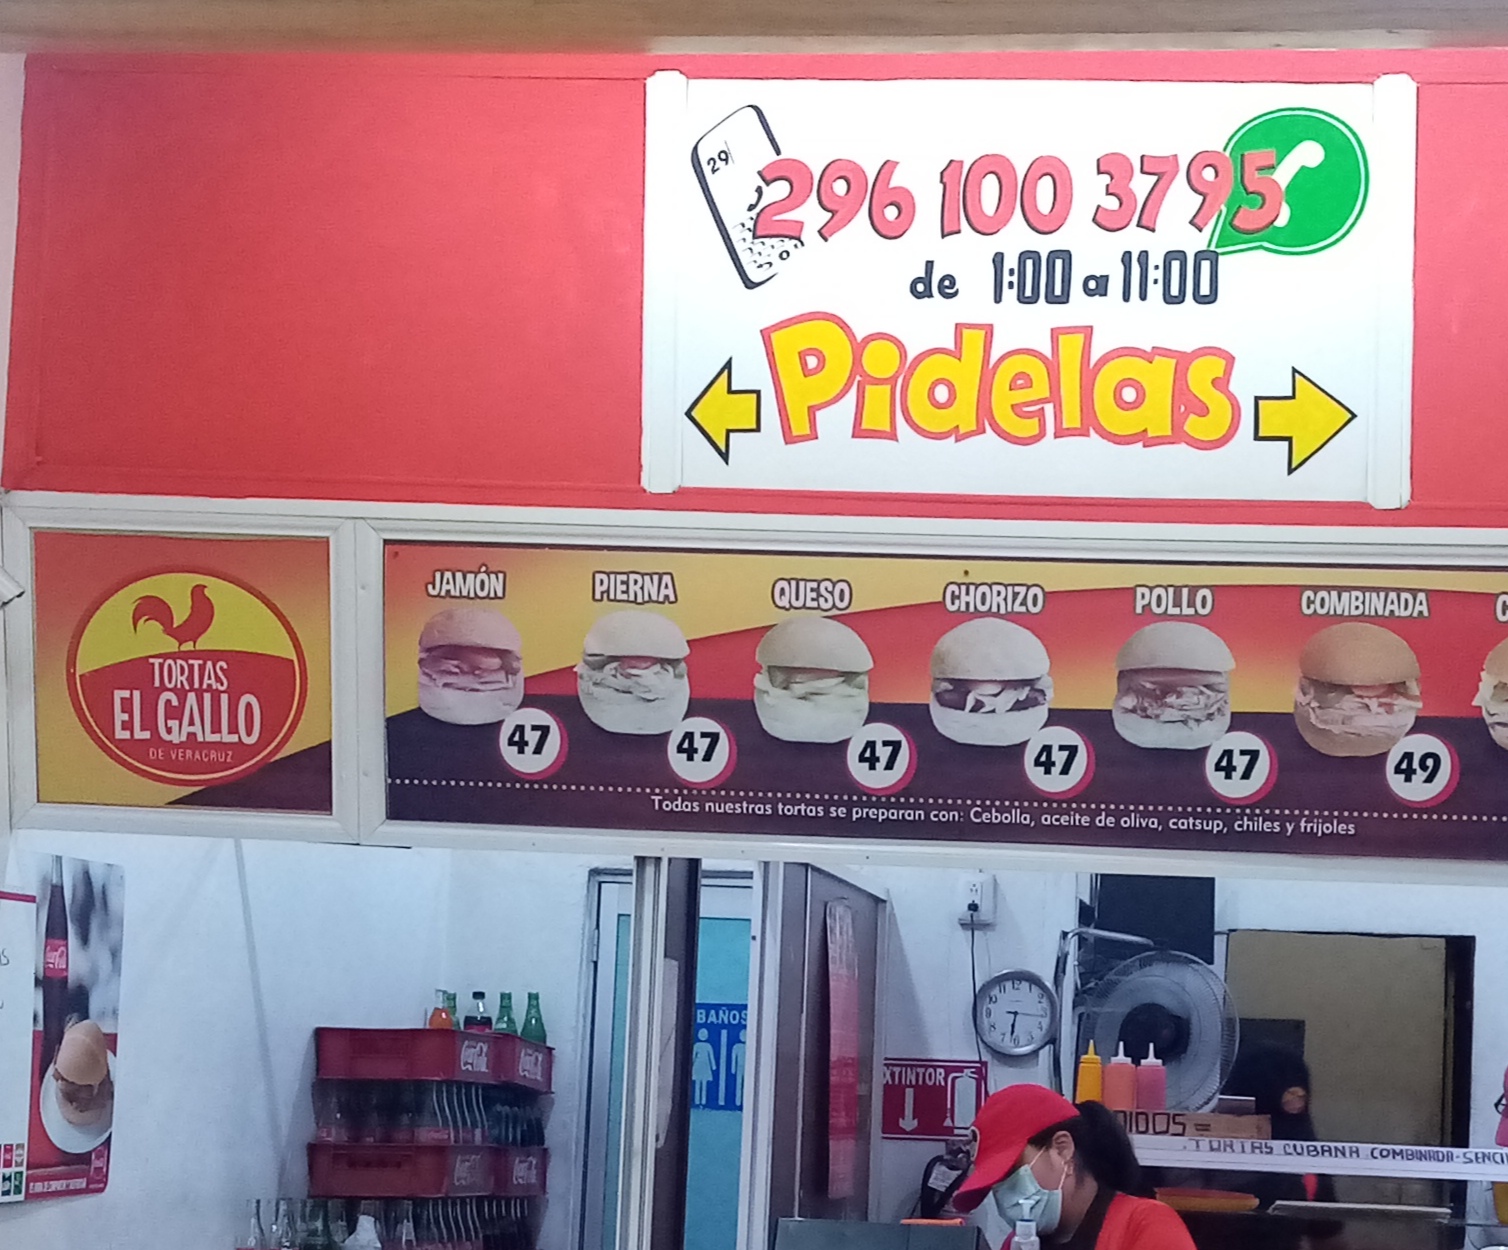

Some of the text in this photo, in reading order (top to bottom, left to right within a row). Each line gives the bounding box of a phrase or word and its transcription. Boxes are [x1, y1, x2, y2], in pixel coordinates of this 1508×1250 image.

[753, 149, 1286, 243] 296 100 3795
[909, 249, 1220, 305] de 1:00 a 11:00
[760, 311, 1242, 450] Pidelas
[427, 564, 506, 599] JAMÓN
[592, 571, 678, 604] PIERNA
[772, 578, 853, 611] QUESO
[943, 582, 1045, 614] CHORIZO
[1133, 585, 1214, 616] POLLO
[1300, 588, 1430, 619] COMBINADA
[149, 657, 229, 691] TORTAS
[112, 689, 262, 745] EL GALLO
[149, 747, 233, 763] DE VERACRUZ
[507, 724, 551, 755] 47
[675, 731, 721, 763] 47
[857, 740, 903, 772] 47
[1033, 744, 1080, 776] 47
[1213, 748, 1261, 780] 47
[1393, 751, 1442, 784] 49
[651, 795, 1356, 837] Todas nuestras tortas se preparan con: Cebolla, aceite de oliva, catsup, chiles y frijoles
[696, 1006, 748, 1025] BAÑOS
[883, 1066, 946, 1087] XTINTOR
[1116, 1110, 1187, 1136] DIDOS
[1283, 1142, 1361, 1159] CUBANA
